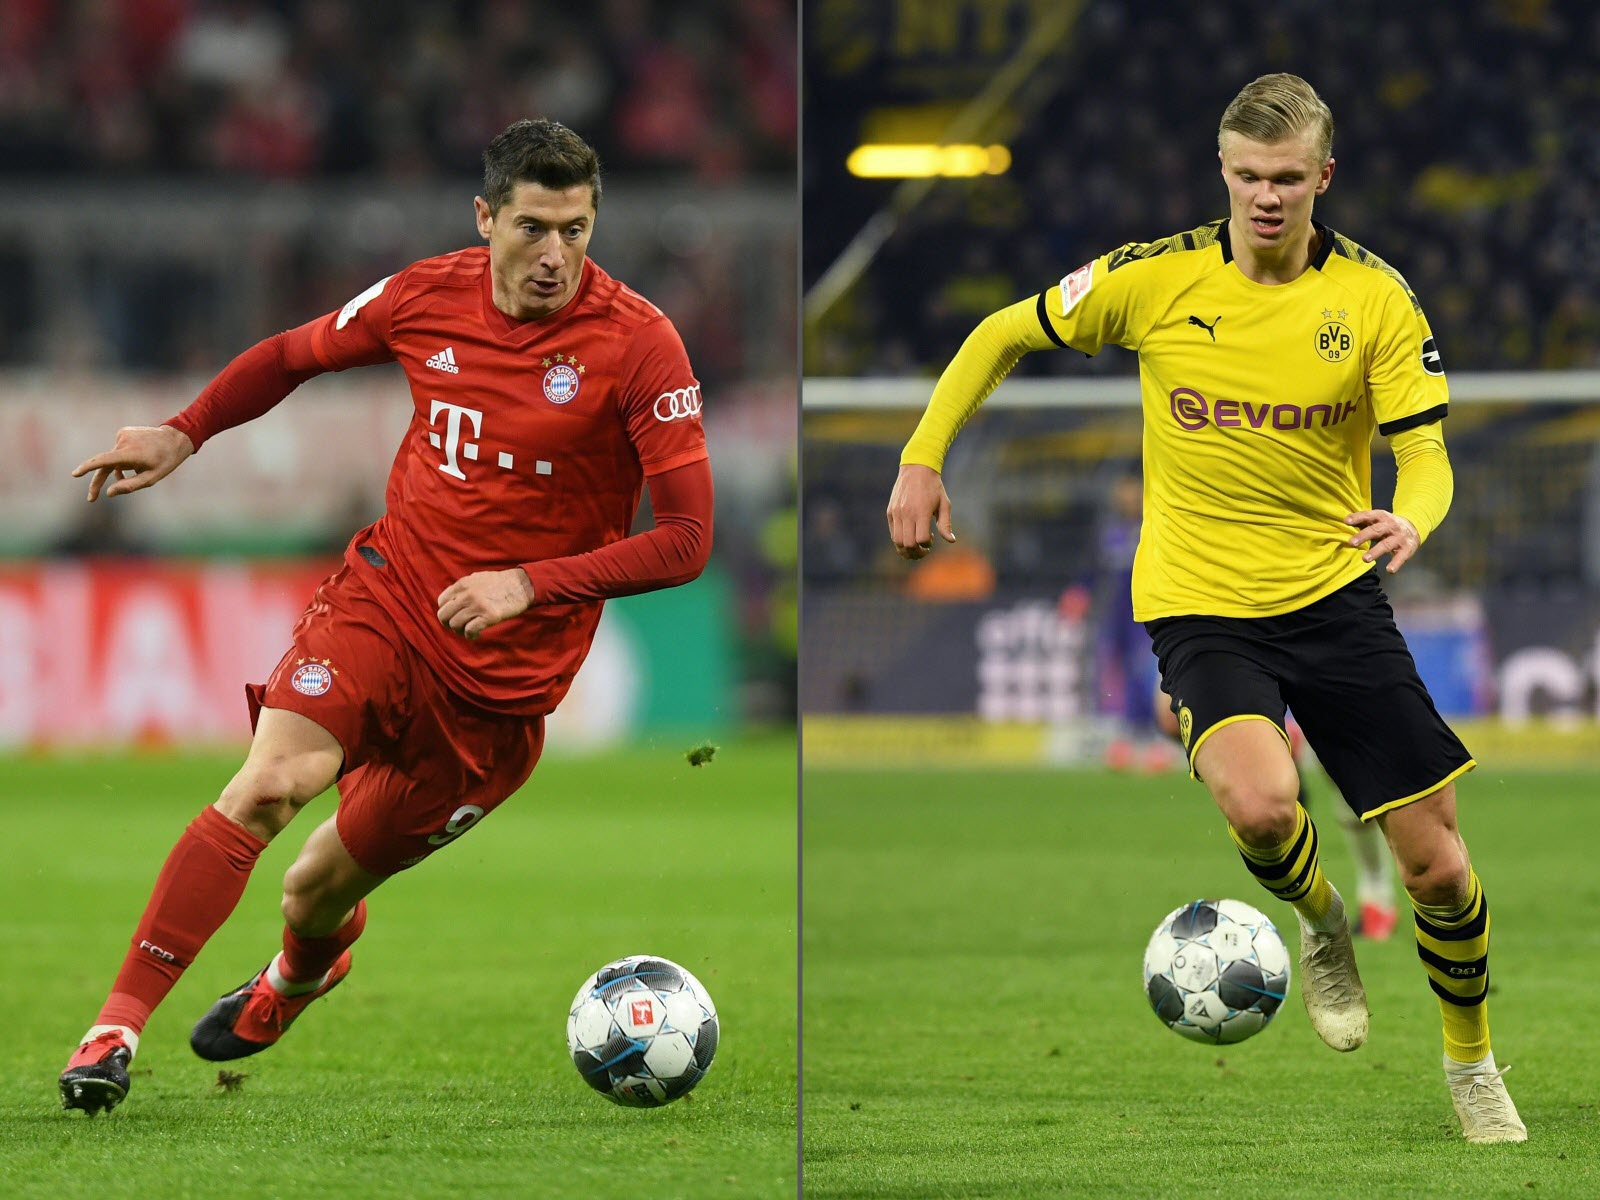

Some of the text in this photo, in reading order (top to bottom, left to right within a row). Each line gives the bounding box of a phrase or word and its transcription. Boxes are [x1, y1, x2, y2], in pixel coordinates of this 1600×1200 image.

[1320, 325, 1350, 351] BVB
[1328, 350, 1340, 359] 09
[426, 358, 460, 375] adidas
[556, 368, 577, 385] BAYERN
[308, 666, 329, 683] BAYERN
[427, 804, 484, 845] 9
